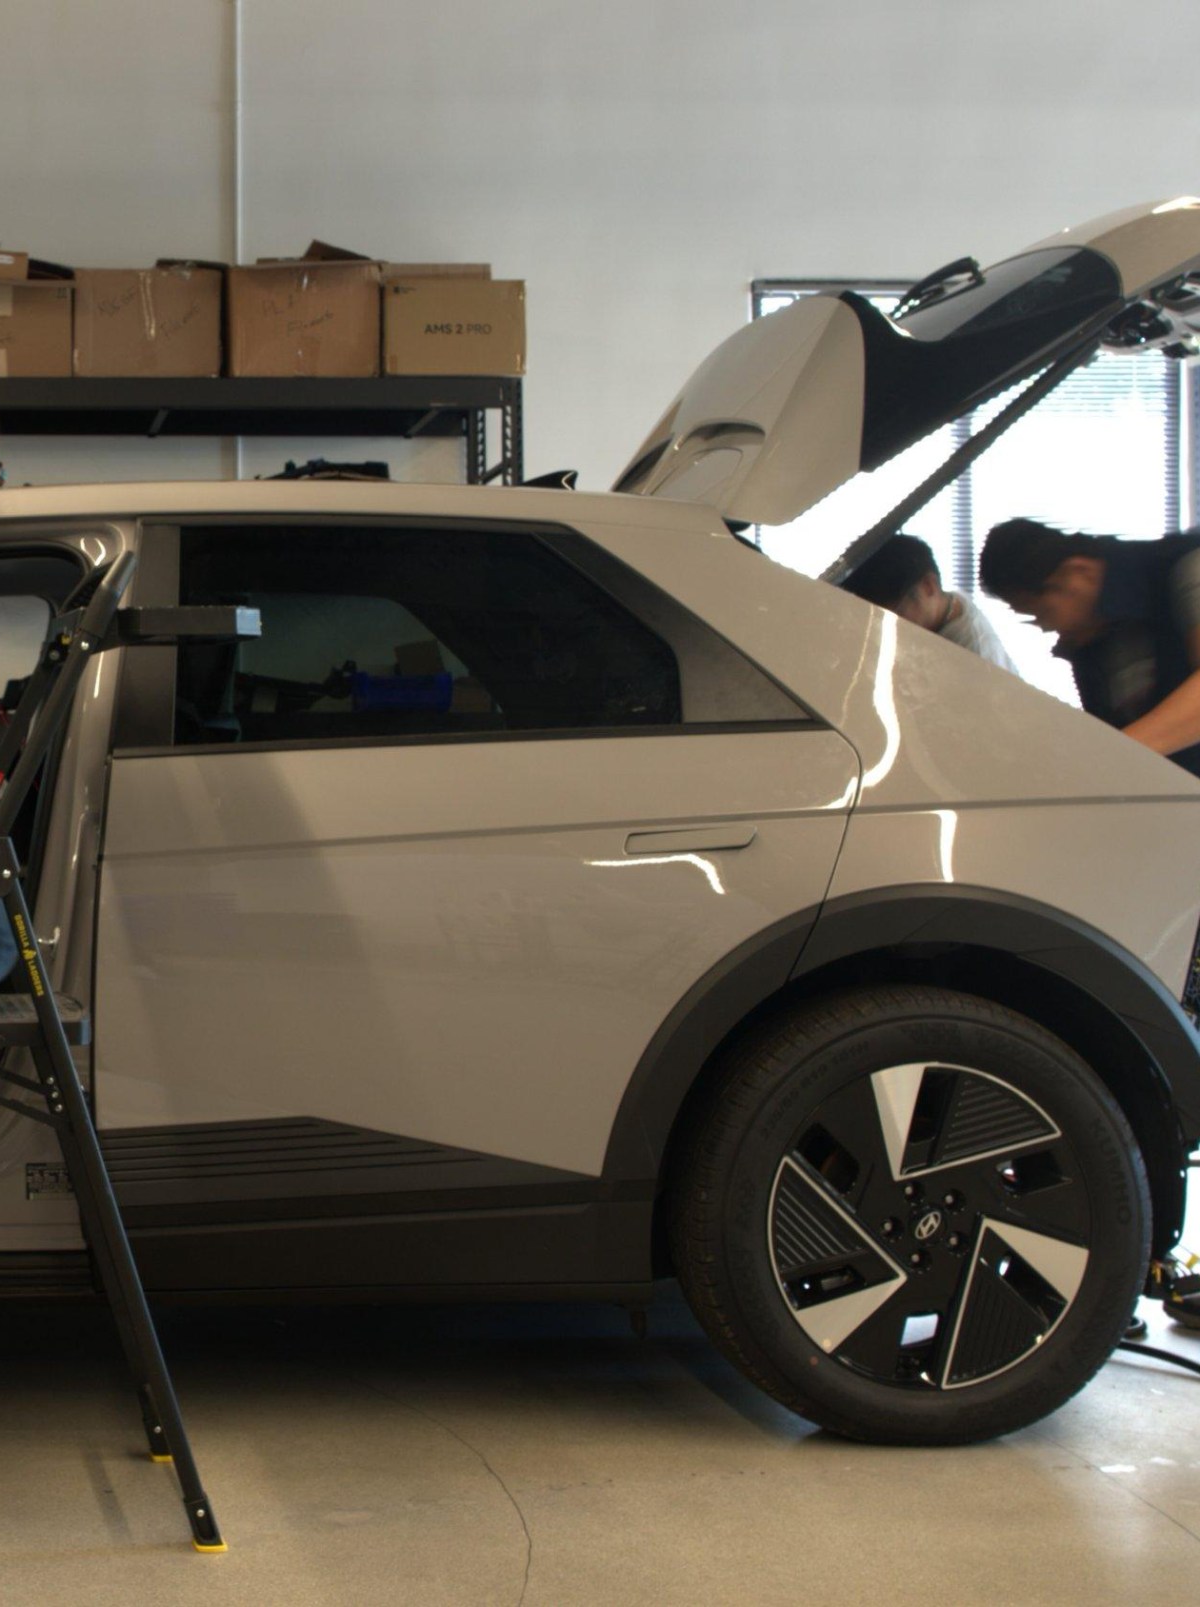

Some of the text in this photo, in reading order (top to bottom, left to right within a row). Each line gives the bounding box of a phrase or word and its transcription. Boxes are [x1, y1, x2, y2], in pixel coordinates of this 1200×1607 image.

[424, 323, 493, 335] AMS 2 PRO
[14, 914, 45, 996] GORILLA LADDERS
